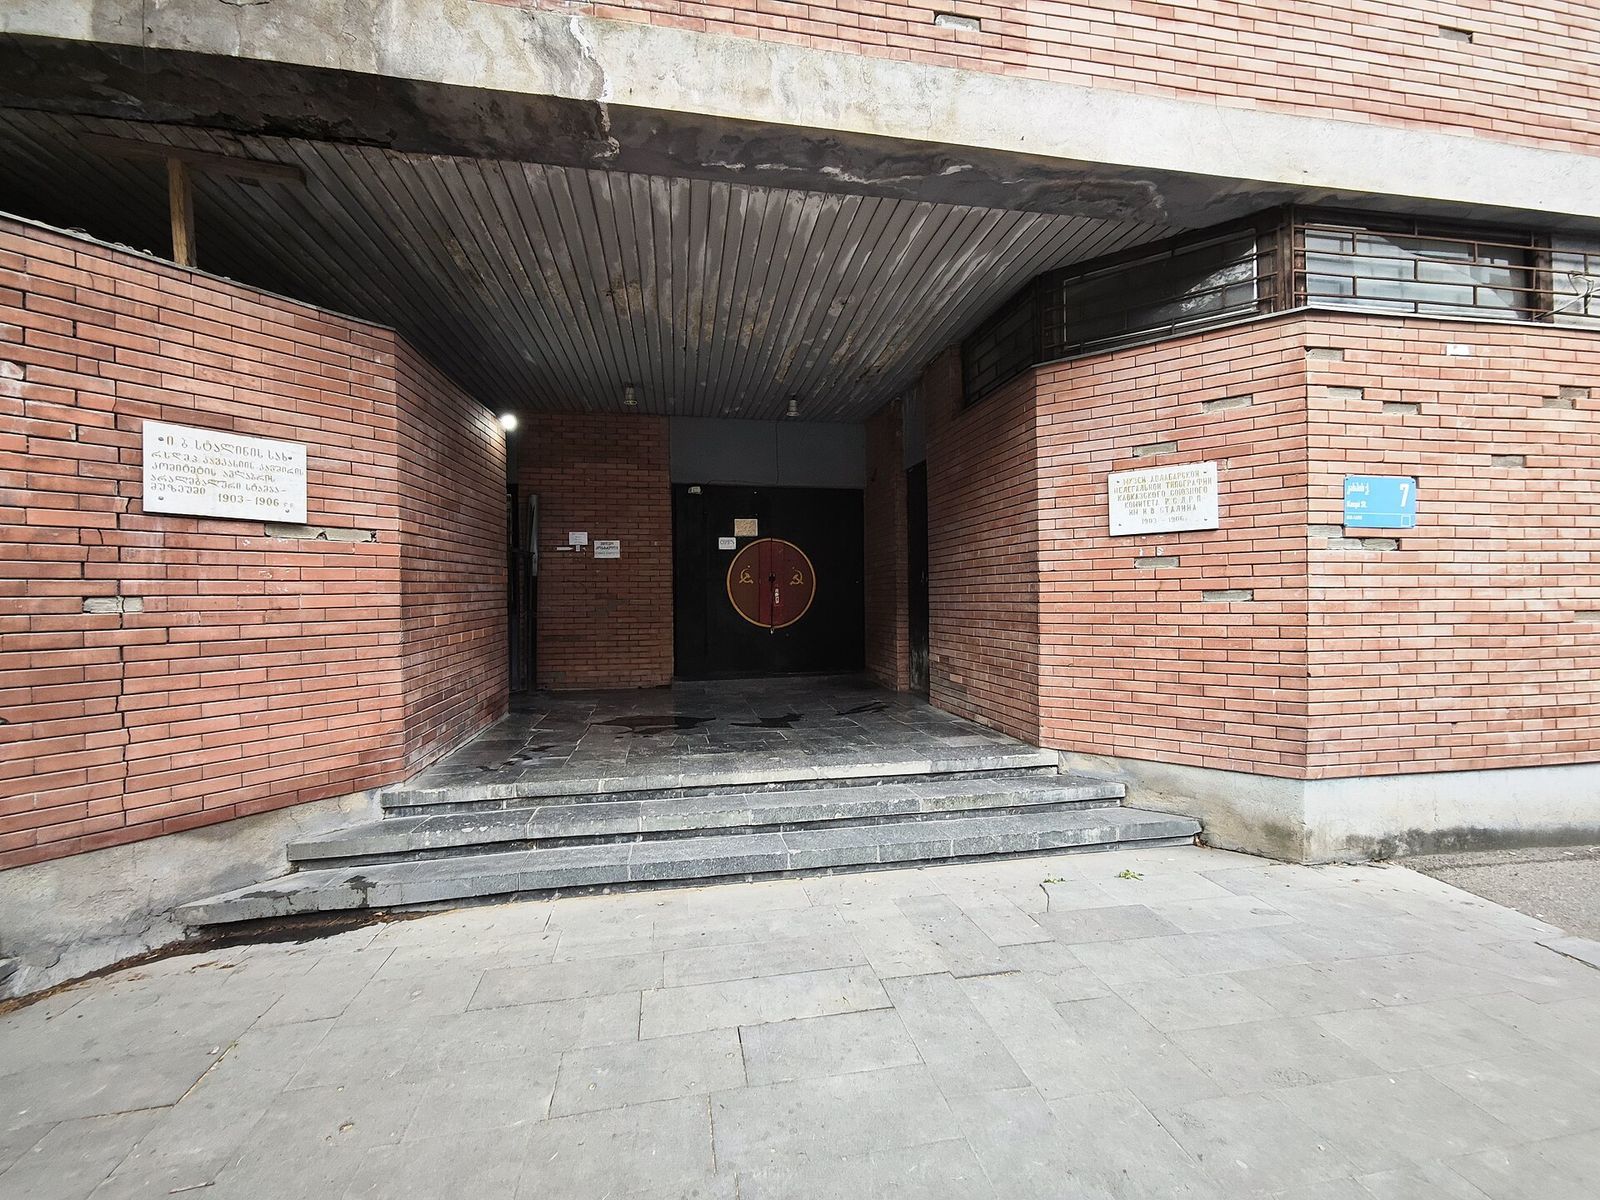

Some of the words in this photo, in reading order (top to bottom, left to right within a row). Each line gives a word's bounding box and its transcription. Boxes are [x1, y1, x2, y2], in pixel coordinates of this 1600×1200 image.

[195, 439, 263, 458] სტალინის
[151, 462, 217, 476] კომიტეტის
[150, 482, 206, 495] მუზეუმი
[218, 493, 244, 503] 1903
[255, 496, 280, 507] 1906
[1117, 490, 1166, 502] КАВКАЗСКОГО
[1399, 483, 1410, 507] 7
